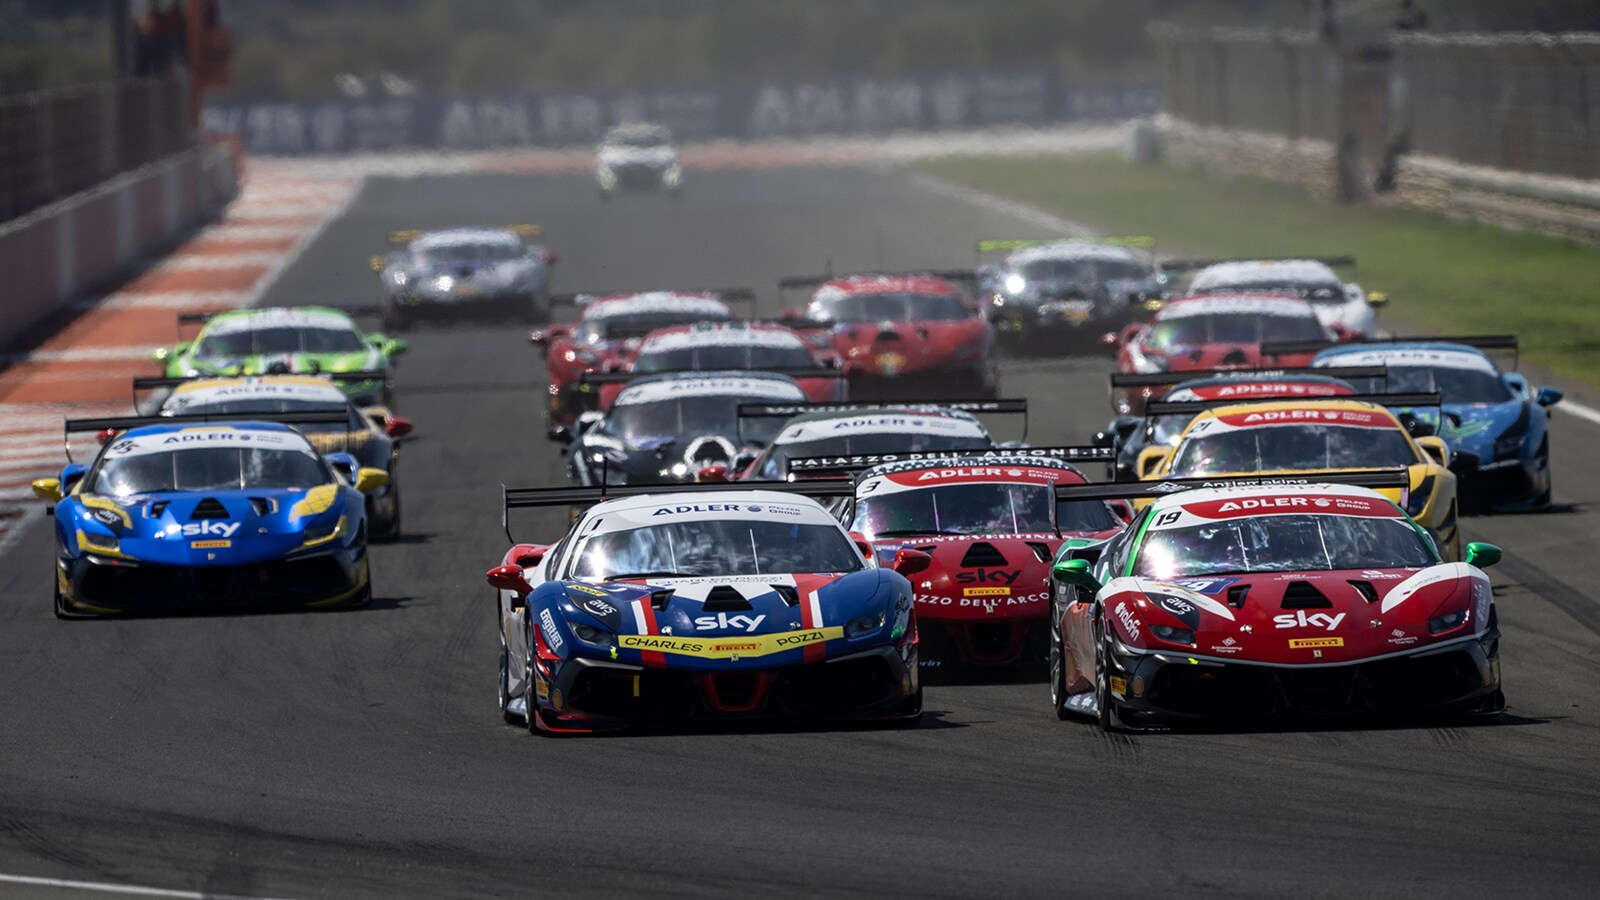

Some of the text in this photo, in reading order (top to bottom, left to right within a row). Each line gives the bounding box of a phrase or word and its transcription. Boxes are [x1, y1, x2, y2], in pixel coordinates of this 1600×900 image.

[1217, 384, 1287, 396] ADLER
[1244, 410, 1319, 422] ADLER
[834, 418, 905, 429] ADLER
[163, 433, 233, 444] ADLER
[790, 455, 898, 466] PALAZZO
[918, 468, 1002, 481] ADLER
[862, 480, 881, 494] 3
[652, 504, 740, 516] ADLER
[1218, 497, 1308, 512] ADLER
[1156, 511, 1182, 527] 19
[182, 519, 241, 537] sky
[955, 568, 1022, 585] sky
[1007, 592, 1049, 605] ARCO
[1166, 597, 1195, 612] aws
[589, 599, 618, 615] aws
[694, 611, 766, 632] sky
[1273, 609, 1347, 631] sky
[624, 631, 825, 652] CHARLES POZZI
[715, 643, 757, 651] PIRELLI
[1294, 639, 1339, 647] PIRELLI
